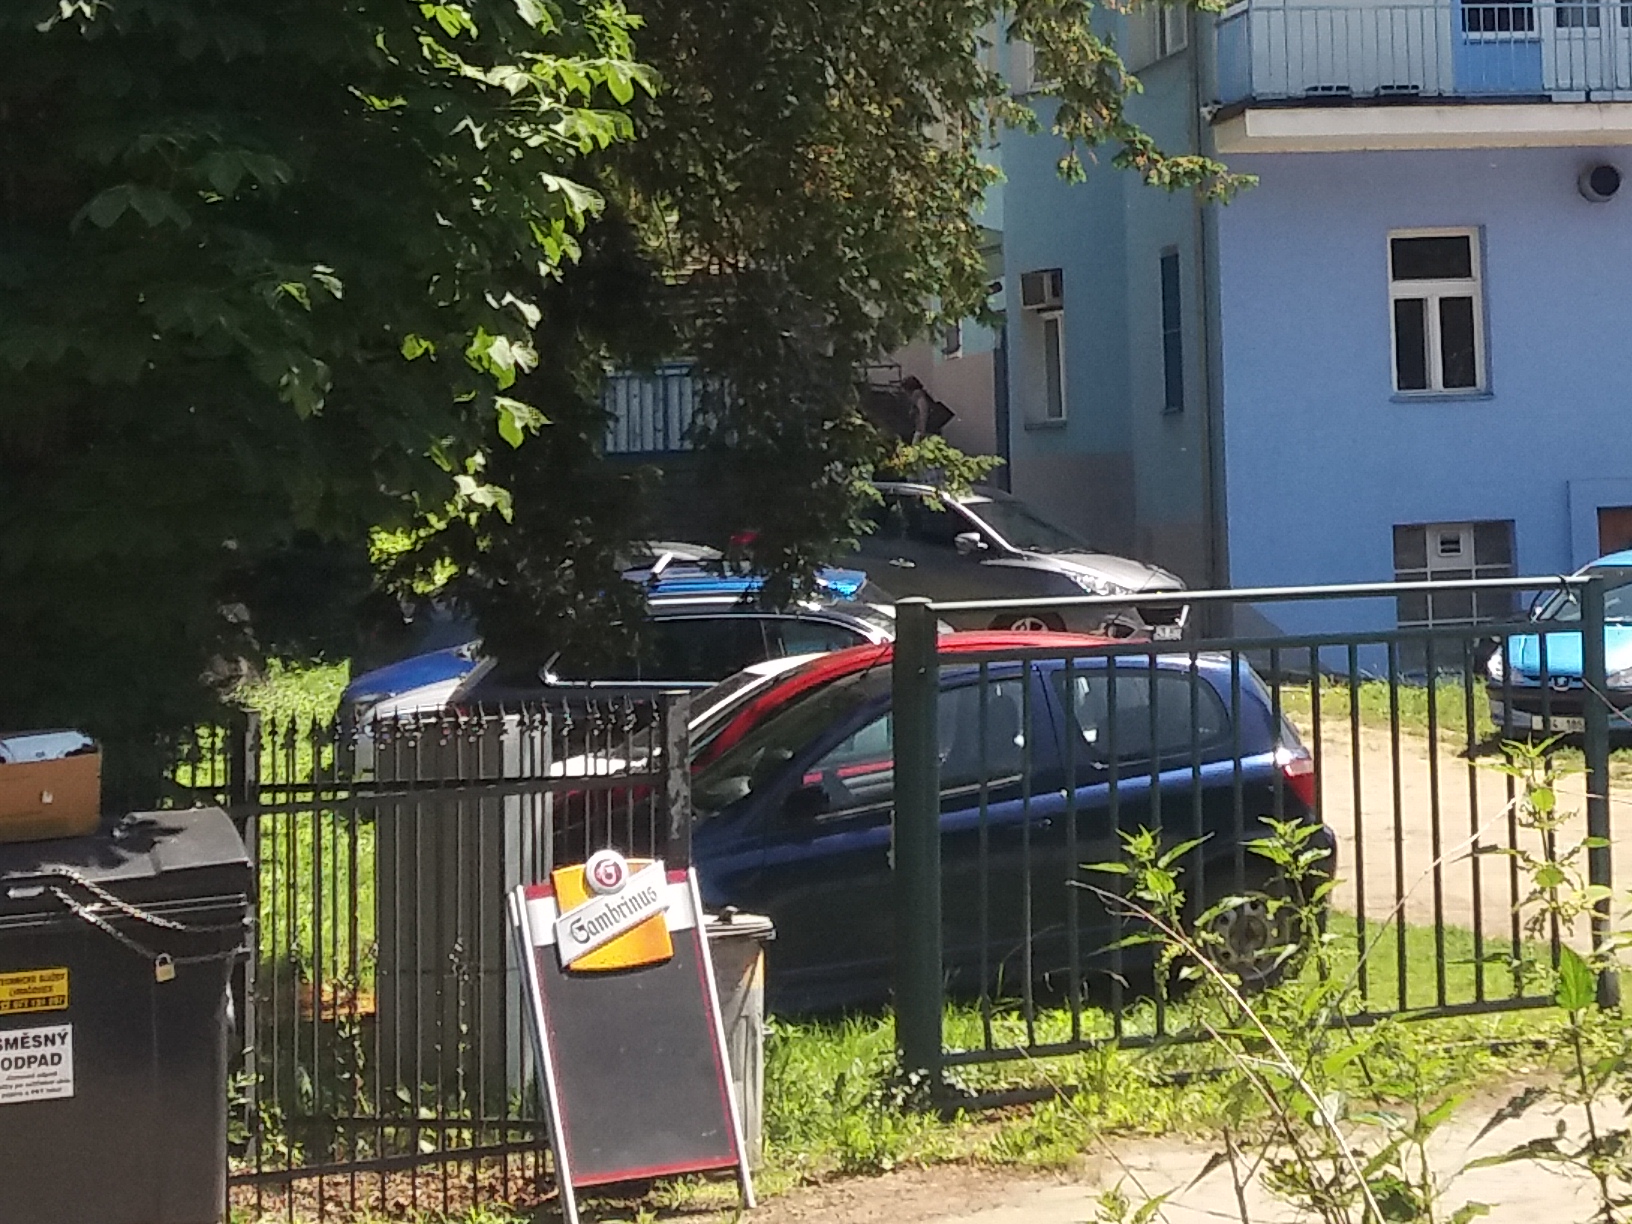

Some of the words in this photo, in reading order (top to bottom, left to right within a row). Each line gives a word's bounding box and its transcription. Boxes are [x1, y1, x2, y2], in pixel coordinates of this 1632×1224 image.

[569, 886, 658, 944] Gambrinus
[0, 1028, 69, 1052] MĚSNÝ
[1, 1052, 63, 1071] ODPAD
